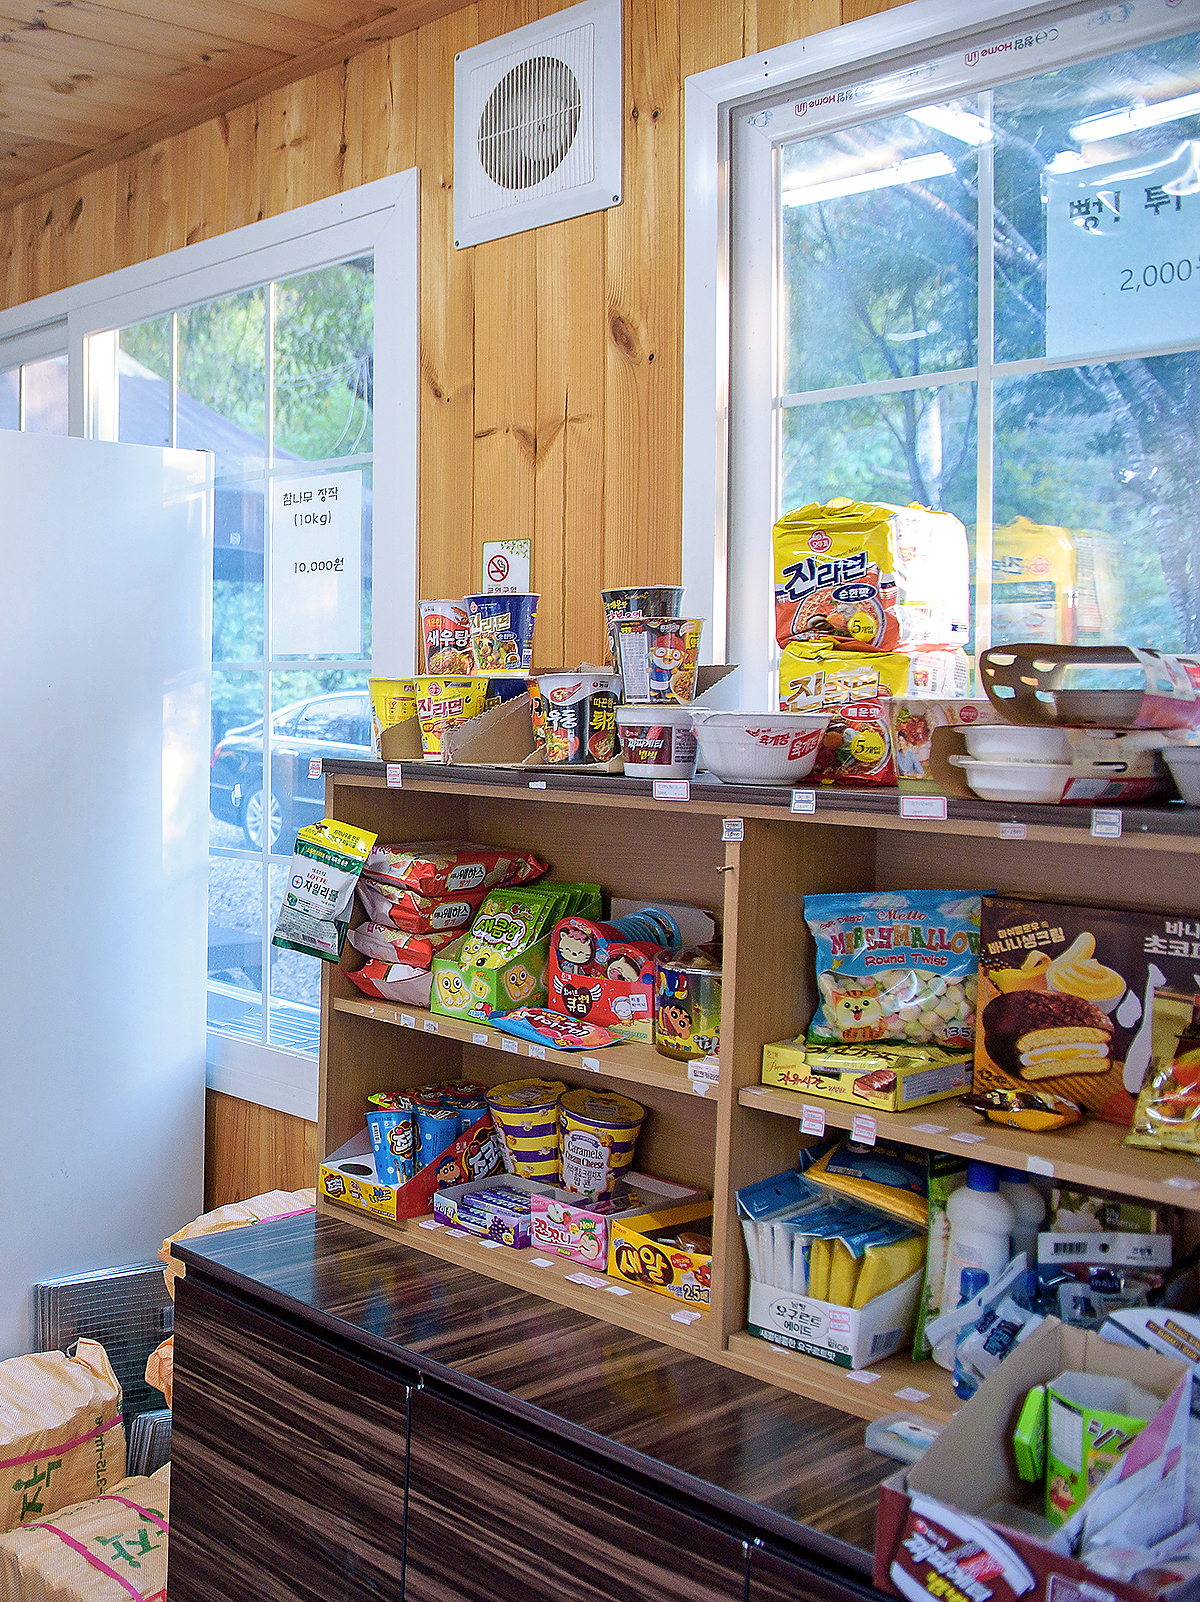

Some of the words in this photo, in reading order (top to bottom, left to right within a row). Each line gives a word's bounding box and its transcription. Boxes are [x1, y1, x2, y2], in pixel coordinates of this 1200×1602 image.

[981, 42, 1013, 57] Home
[282, 491, 313, 506] 참나무
[317, 486, 339, 503] 장작
[293, 510, 332, 527] (10kg)
[782, 551, 869, 603] 진라면
[839, 589, 870, 599] 순한맛
[469, 612, 511, 637] 진라면
[426, 629, 471, 647] 새우탕
[417, 696, 464, 721] 진라면
[546, 709, 578, 732] 우동
[303, 879, 340, 902] 자일리톨
[876, 910, 927, 921] Mello
[987, 927, 1066, 955] 바나나생크림
[864, 954, 906, 966] Round
[910, 953, 949, 966] Twist
[777, 1071, 828, 1090] 자유시간
[567, 1140, 604, 1160] Caramel&
[581, 1157, 605, 1170] Cheese
[619, 1246, 670, 1286] 새알
[775, 1305, 823, 1328] 요구르트
[784, 1321, 812, 1337] 에이드
